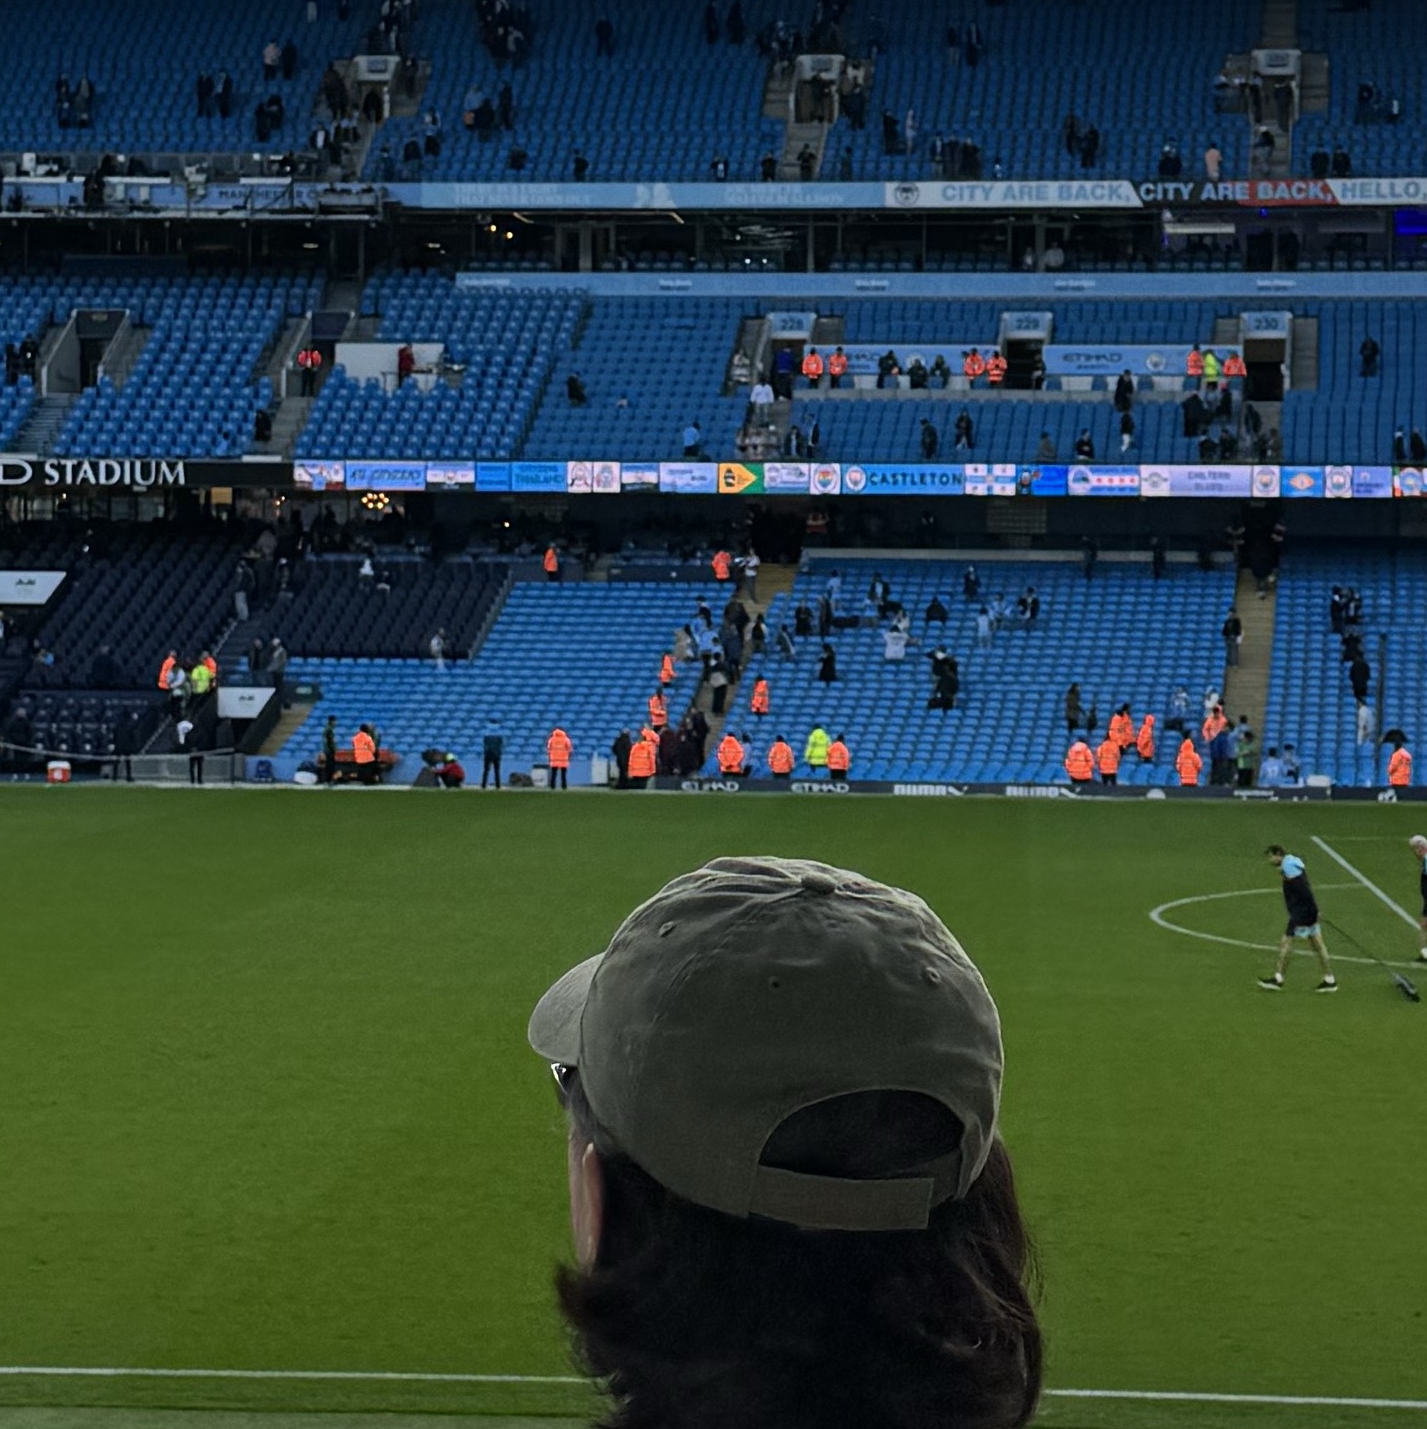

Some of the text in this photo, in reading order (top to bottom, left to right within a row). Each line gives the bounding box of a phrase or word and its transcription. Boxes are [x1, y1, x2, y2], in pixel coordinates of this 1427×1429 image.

[941, 183, 1131, 204] CITY ARE BACK,
[1139, 182, 1195, 202] CITY
[1200, 182, 1250, 202] ARE
[1258, 182, 1334, 204] BACK,
[1253, 317, 1279, 330] 230
[1062, 353, 1123, 363] ETIHAD
[44, 459, 186, 485] STADIUM
[868, 471, 962, 486] CASTLETON
[791, 782, 850, 793] ETIHAD
[893, 784, 947, 796] PUMA
[1005, 785, 1059, 797] PUMA
